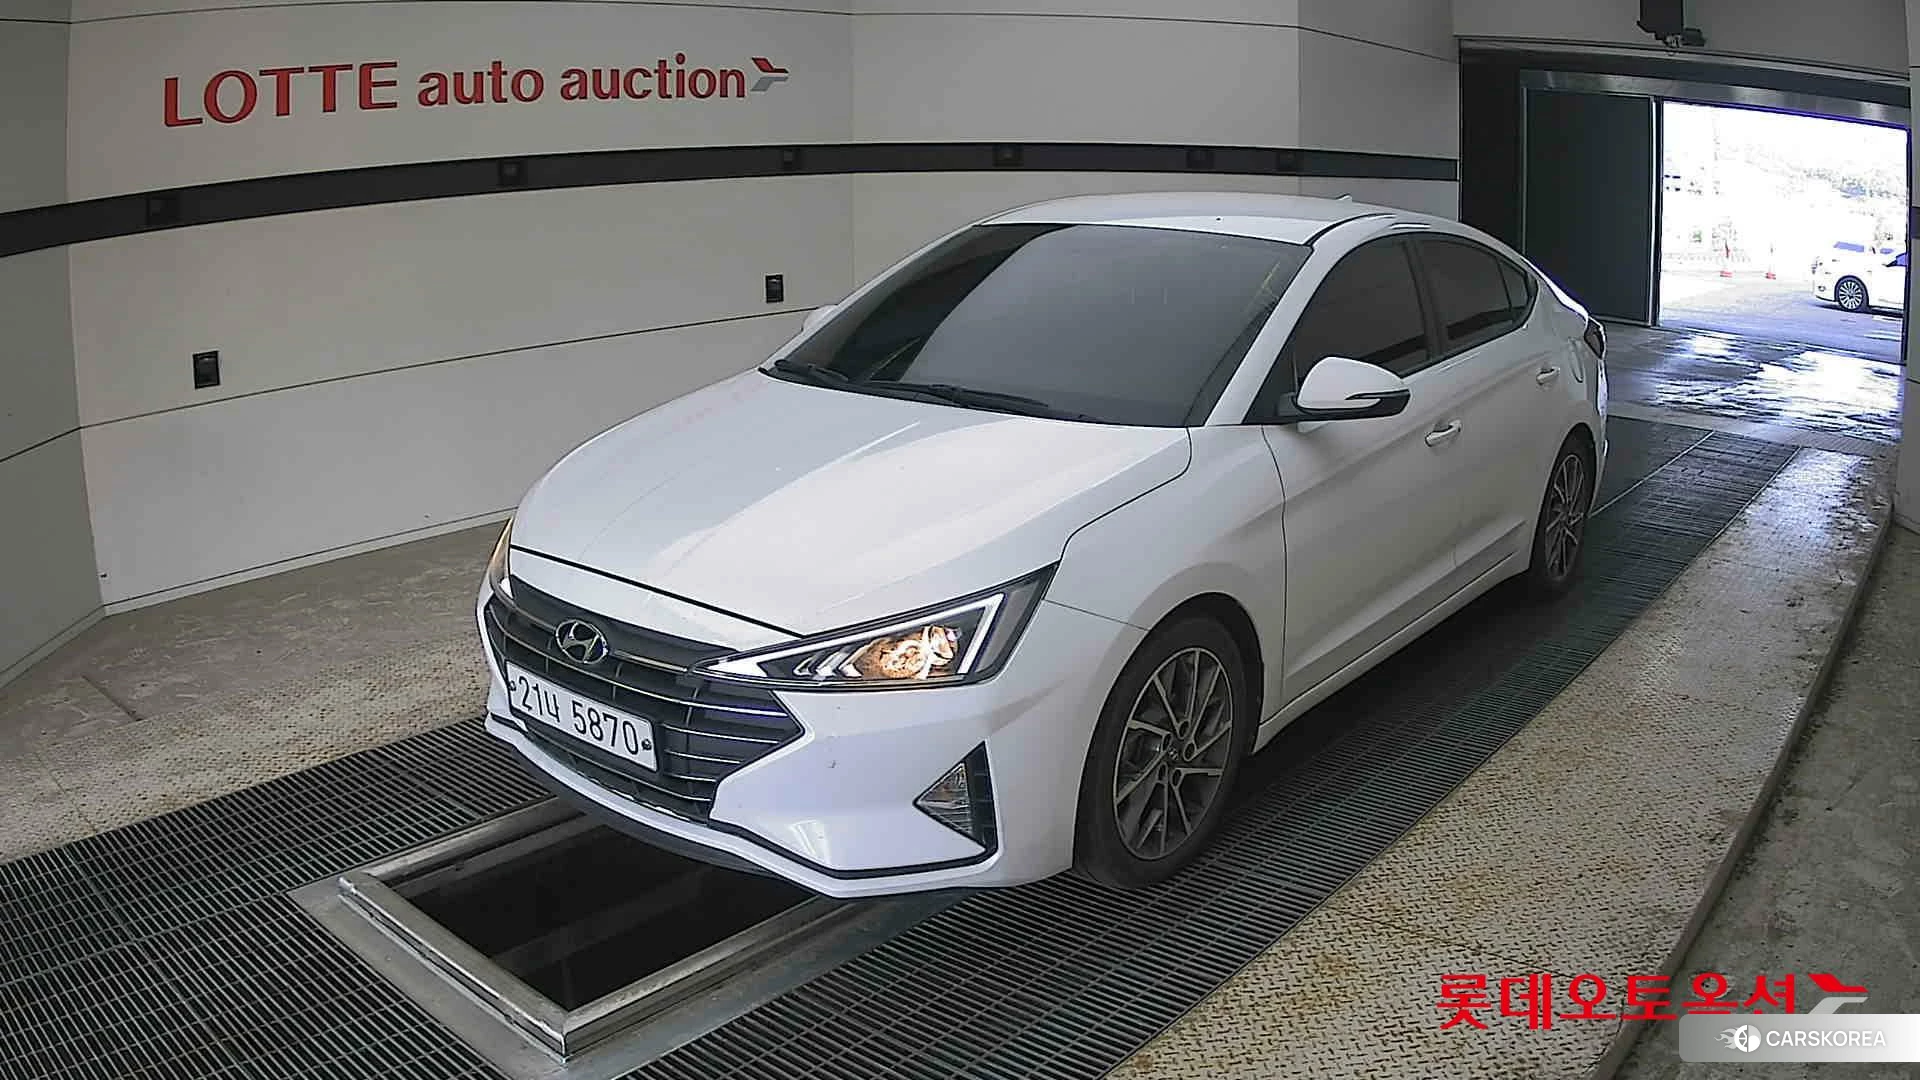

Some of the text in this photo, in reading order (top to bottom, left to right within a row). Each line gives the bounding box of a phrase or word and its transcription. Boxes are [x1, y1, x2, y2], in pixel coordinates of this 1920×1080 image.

[164, 52, 745, 127] LOTTE auto auction
[572, 699, 639, 755] 5870
